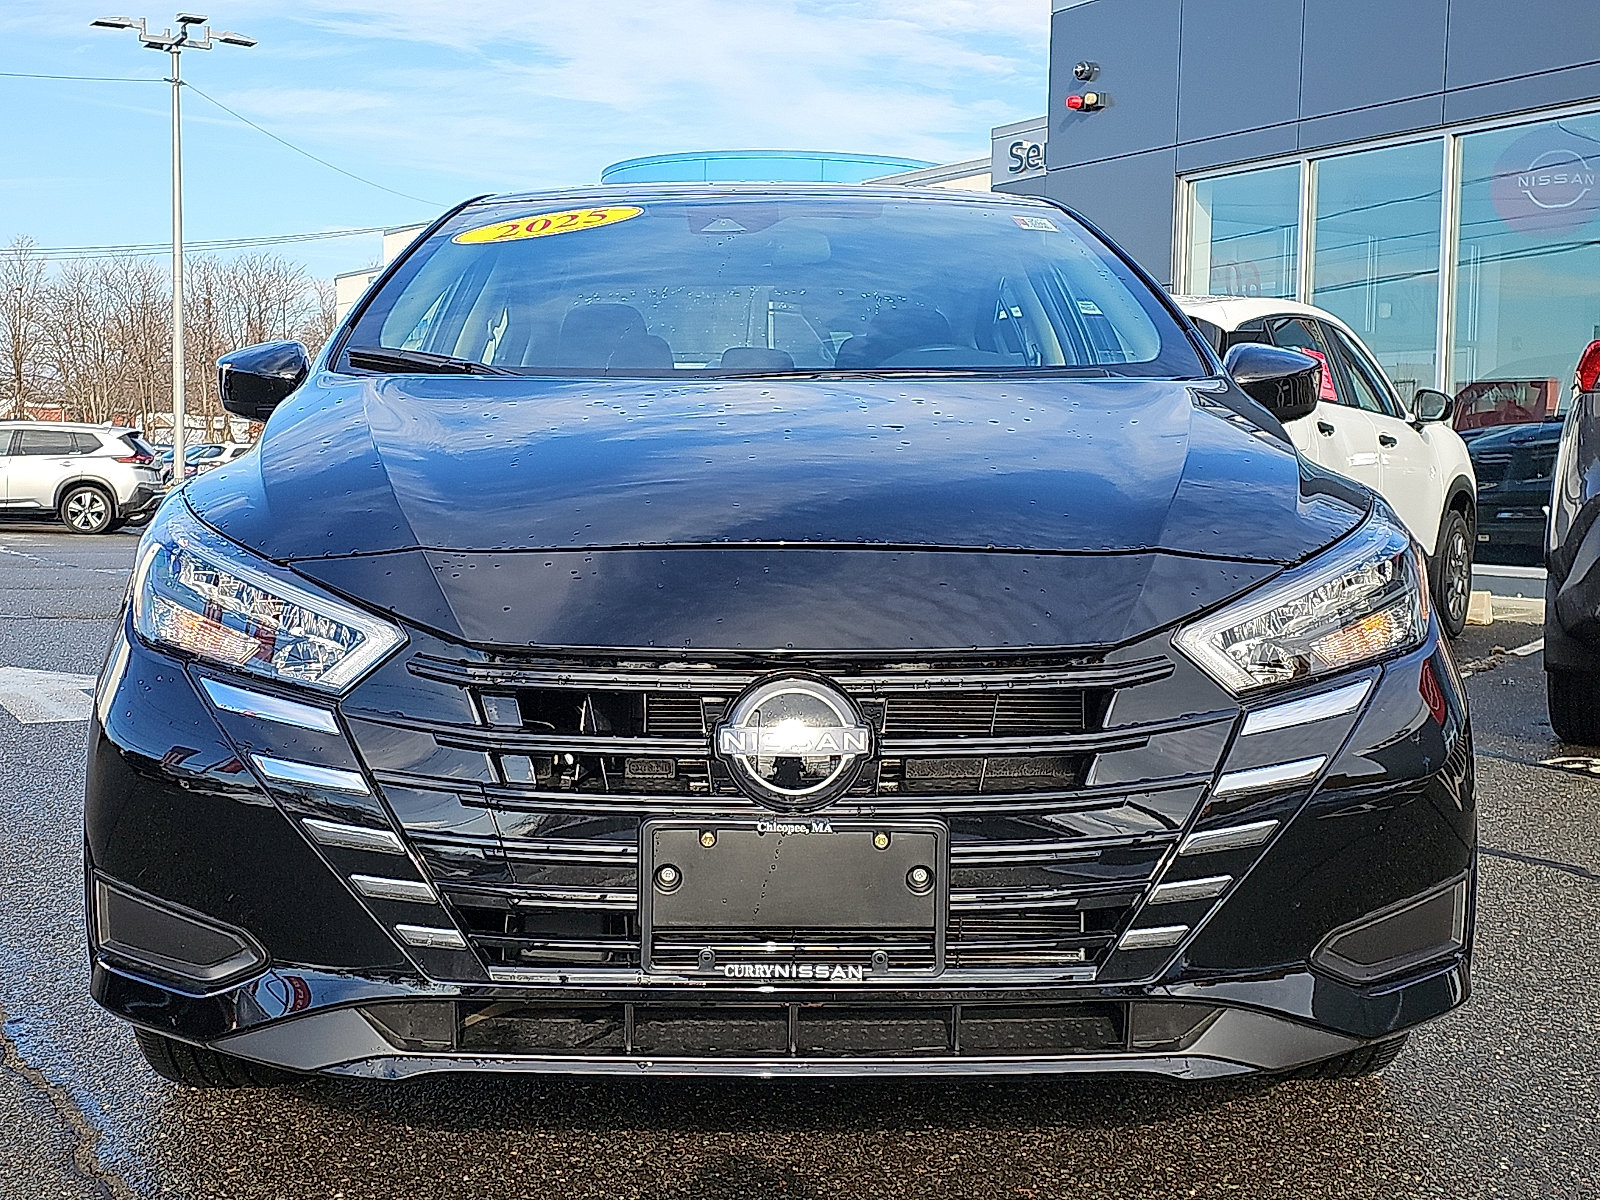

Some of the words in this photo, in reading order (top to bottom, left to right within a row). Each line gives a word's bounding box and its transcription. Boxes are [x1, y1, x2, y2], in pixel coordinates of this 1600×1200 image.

[1008, 141, 1047, 171] Se
[1518, 174, 1595, 187] NISSAN
[492, 209, 609, 240] 2025
[811, 822, 833, 833] MA
